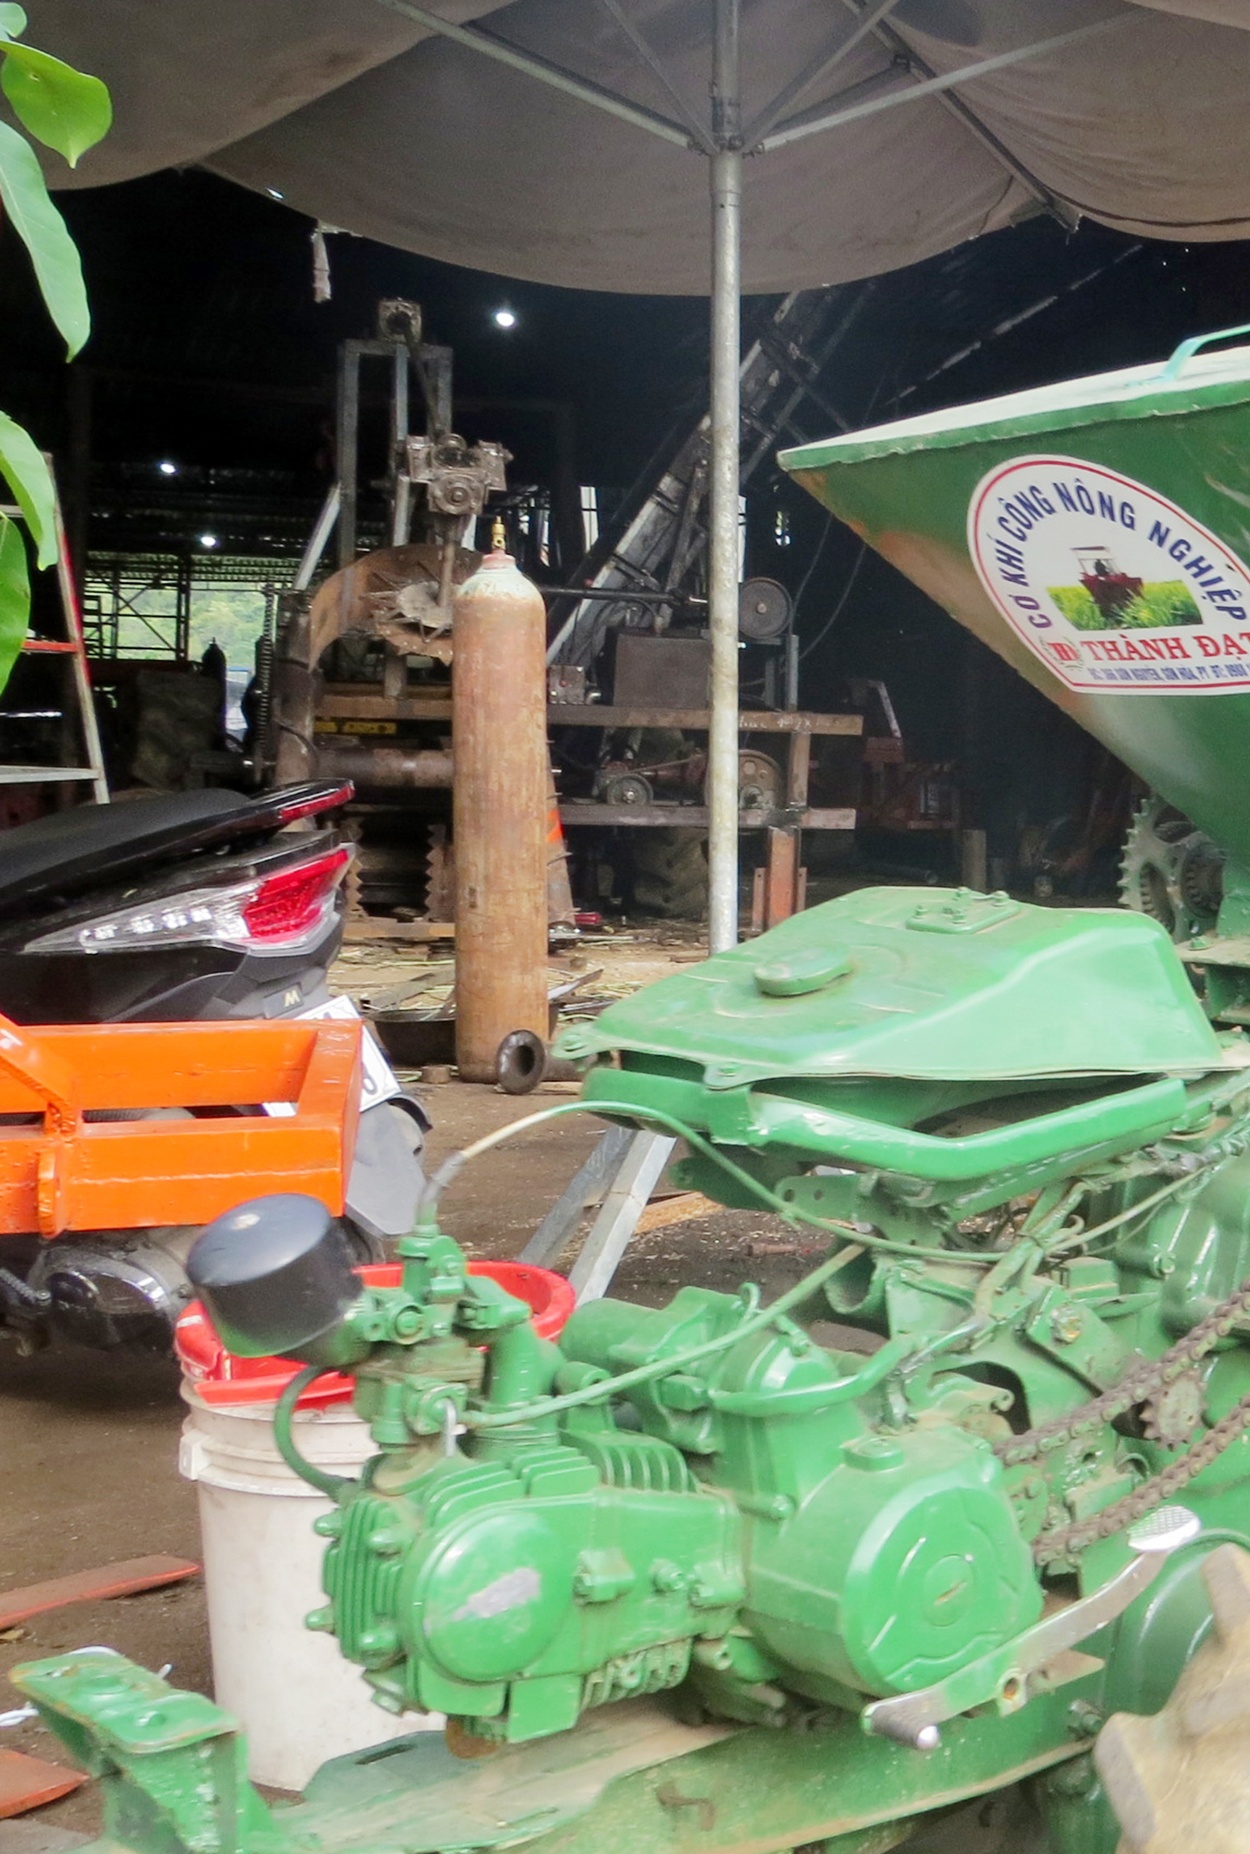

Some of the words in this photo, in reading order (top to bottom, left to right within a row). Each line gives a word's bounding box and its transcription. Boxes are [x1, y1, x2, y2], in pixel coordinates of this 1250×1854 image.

[996, 484, 1057, 542] CÔNG
[1052, 477, 1136, 531] NÔNG
[987, 532, 1030, 587] KHÍ
[1147, 519, 1248, 621] NGHIỆP
[1008, 594, 1053, 629] CƠ
[1080, 633, 1190, 662] THÀNH
